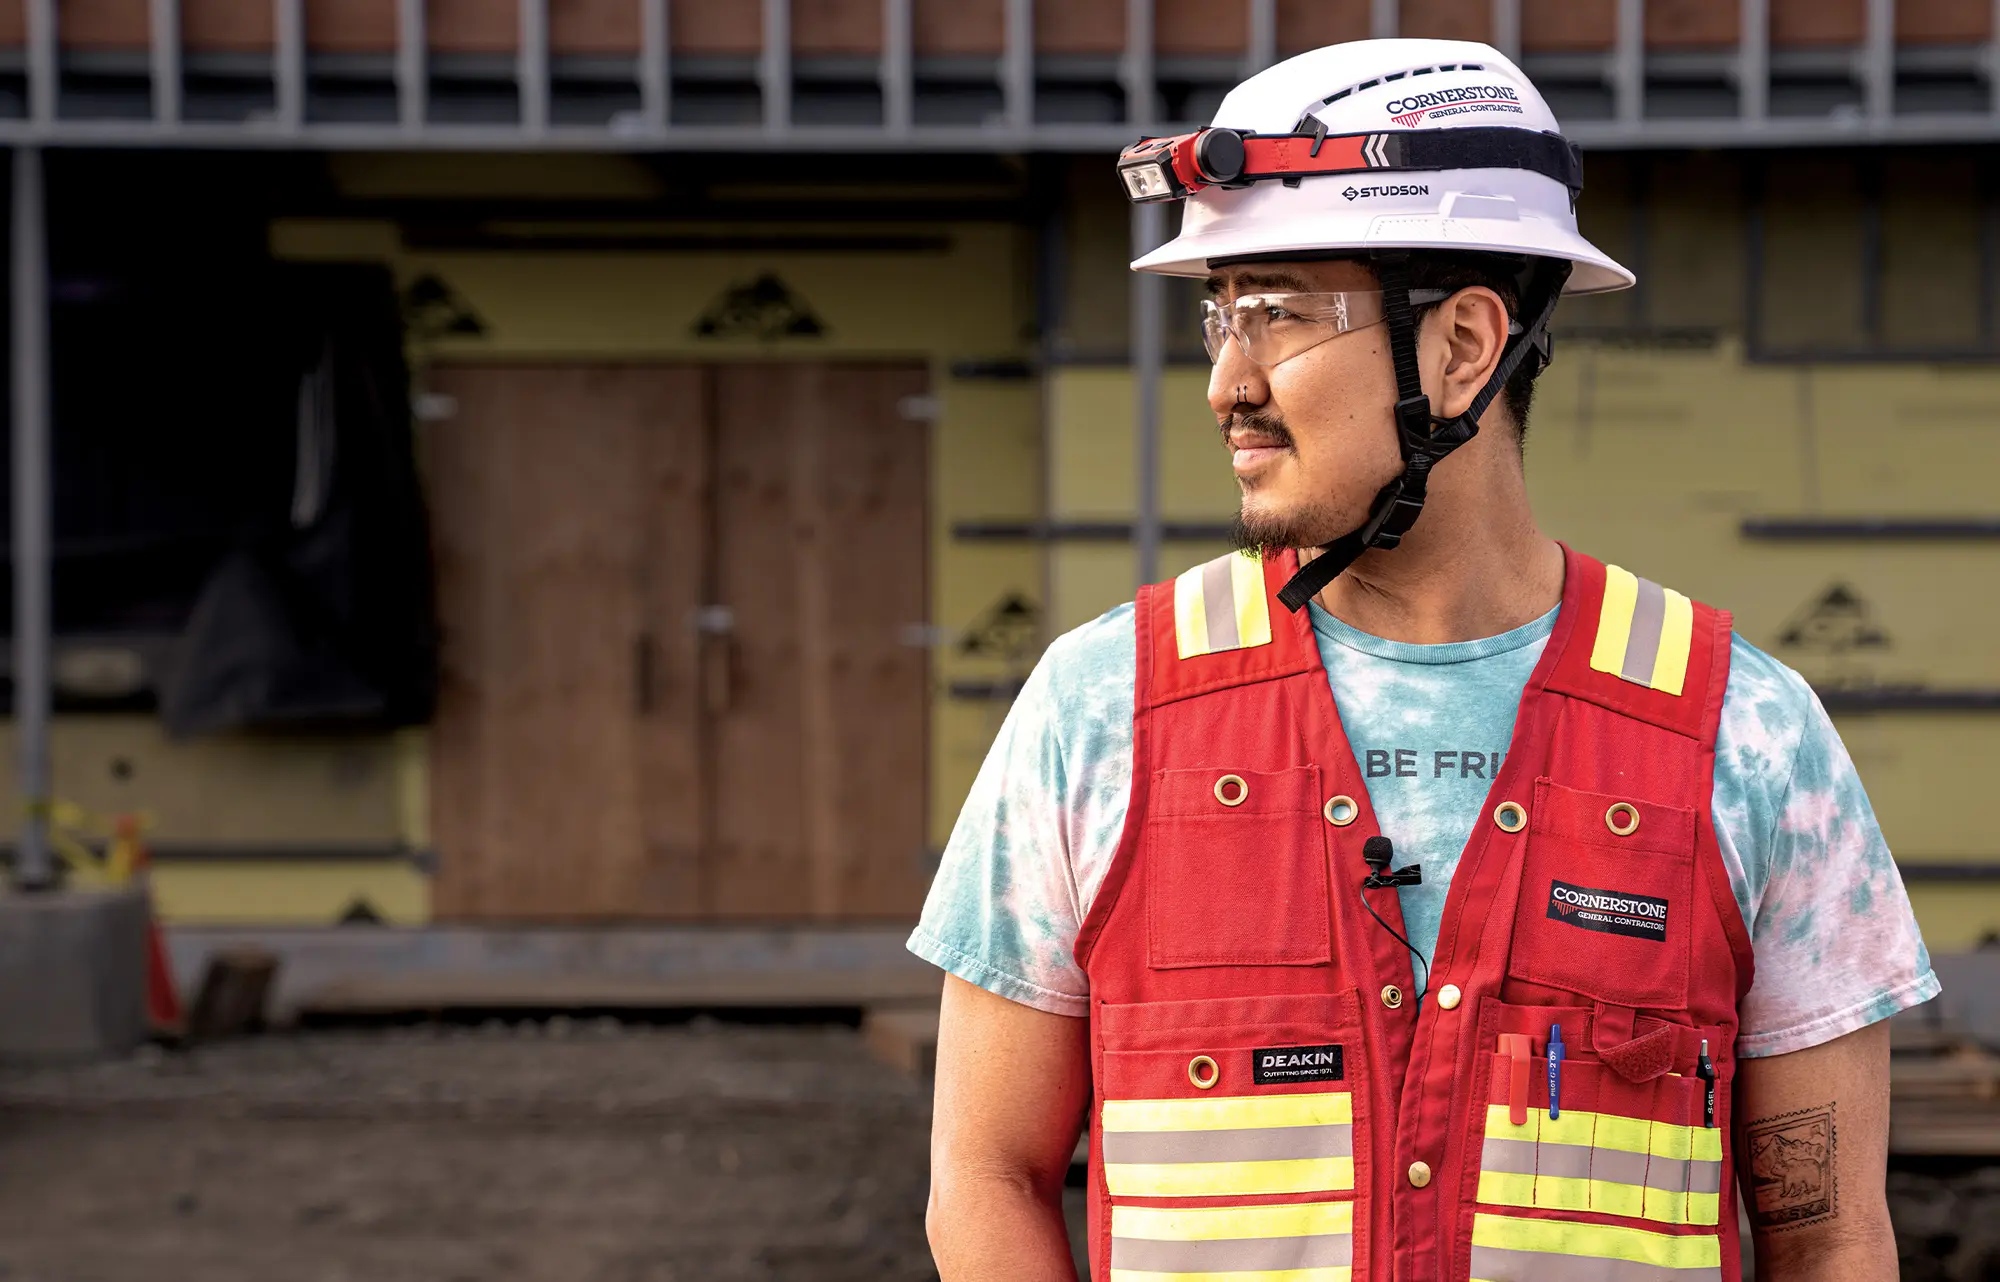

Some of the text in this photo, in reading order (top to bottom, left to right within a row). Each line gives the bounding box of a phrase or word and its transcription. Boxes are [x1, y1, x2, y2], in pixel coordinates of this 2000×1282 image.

[1386, 86, 1518, 114] CORNERSTONE
[1429, 104, 1523, 119] GENERAL CONTRACTORS
[1360, 185, 1429, 197] STUDSON
[1366, 749, 1509, 779] BE FRI
[1553, 887, 1667, 919] CORNERSTONE
[1577, 911, 1665, 931] GENERAL CONTRACTORS
[1262, 1052, 1333, 1068] DEAKIN
